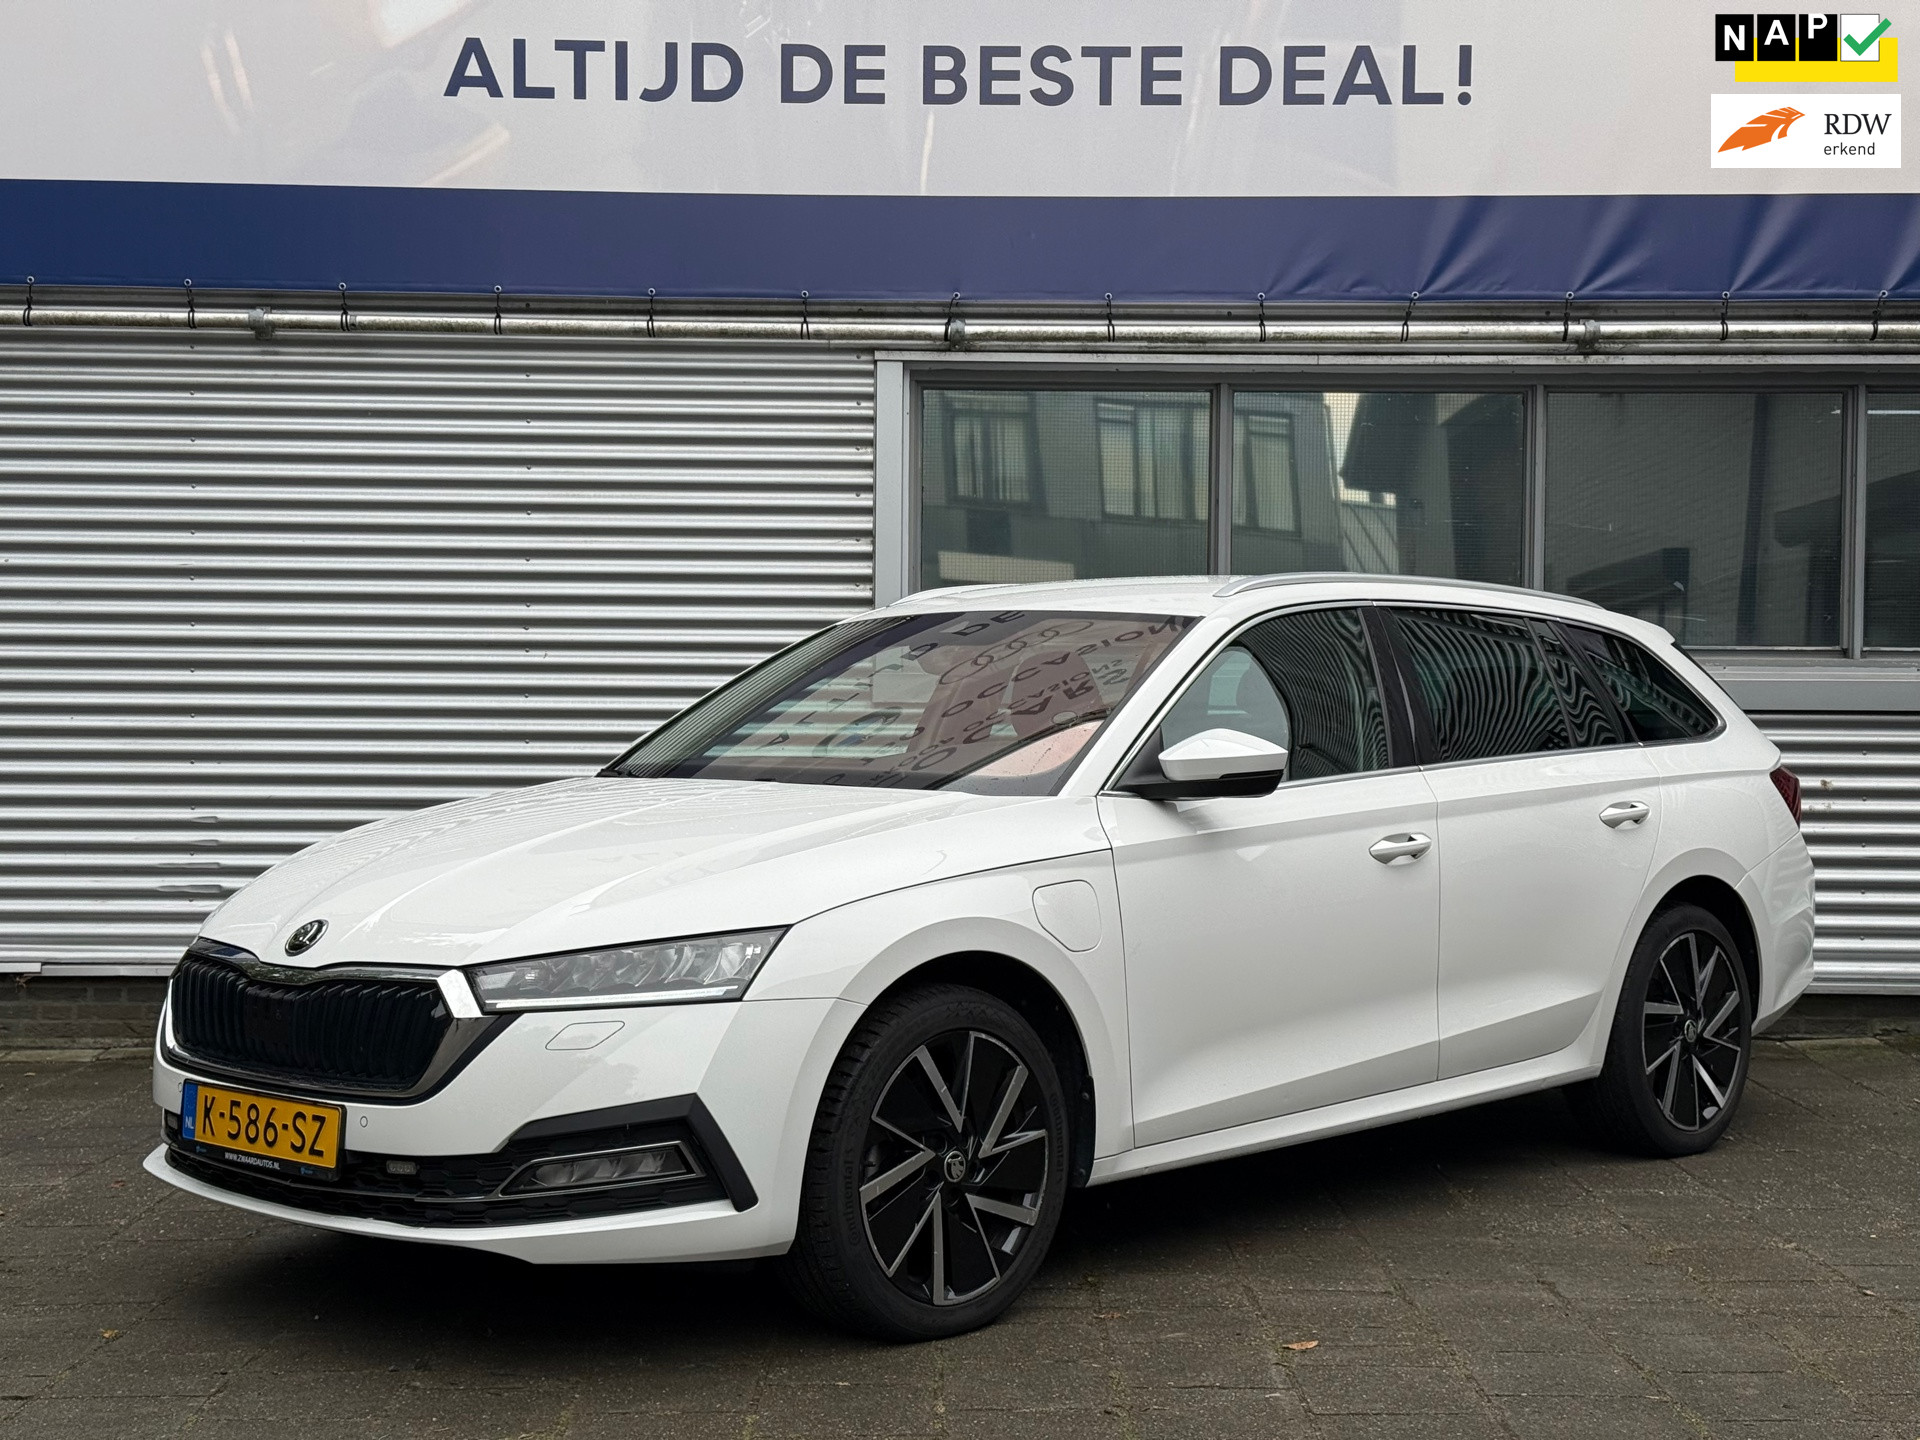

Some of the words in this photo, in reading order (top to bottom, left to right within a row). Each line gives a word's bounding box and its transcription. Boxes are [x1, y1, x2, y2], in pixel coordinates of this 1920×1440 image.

[443, 37, 744, 103] ALTIJD
[780, 43, 886, 105] DE
[922, 44, 1184, 107] BESTE
[1219, 44, 1473, 106] DEAL!
[185, 1115, 195, 1130] NL
[202, 1094, 327, 1158] K-586-SZ
